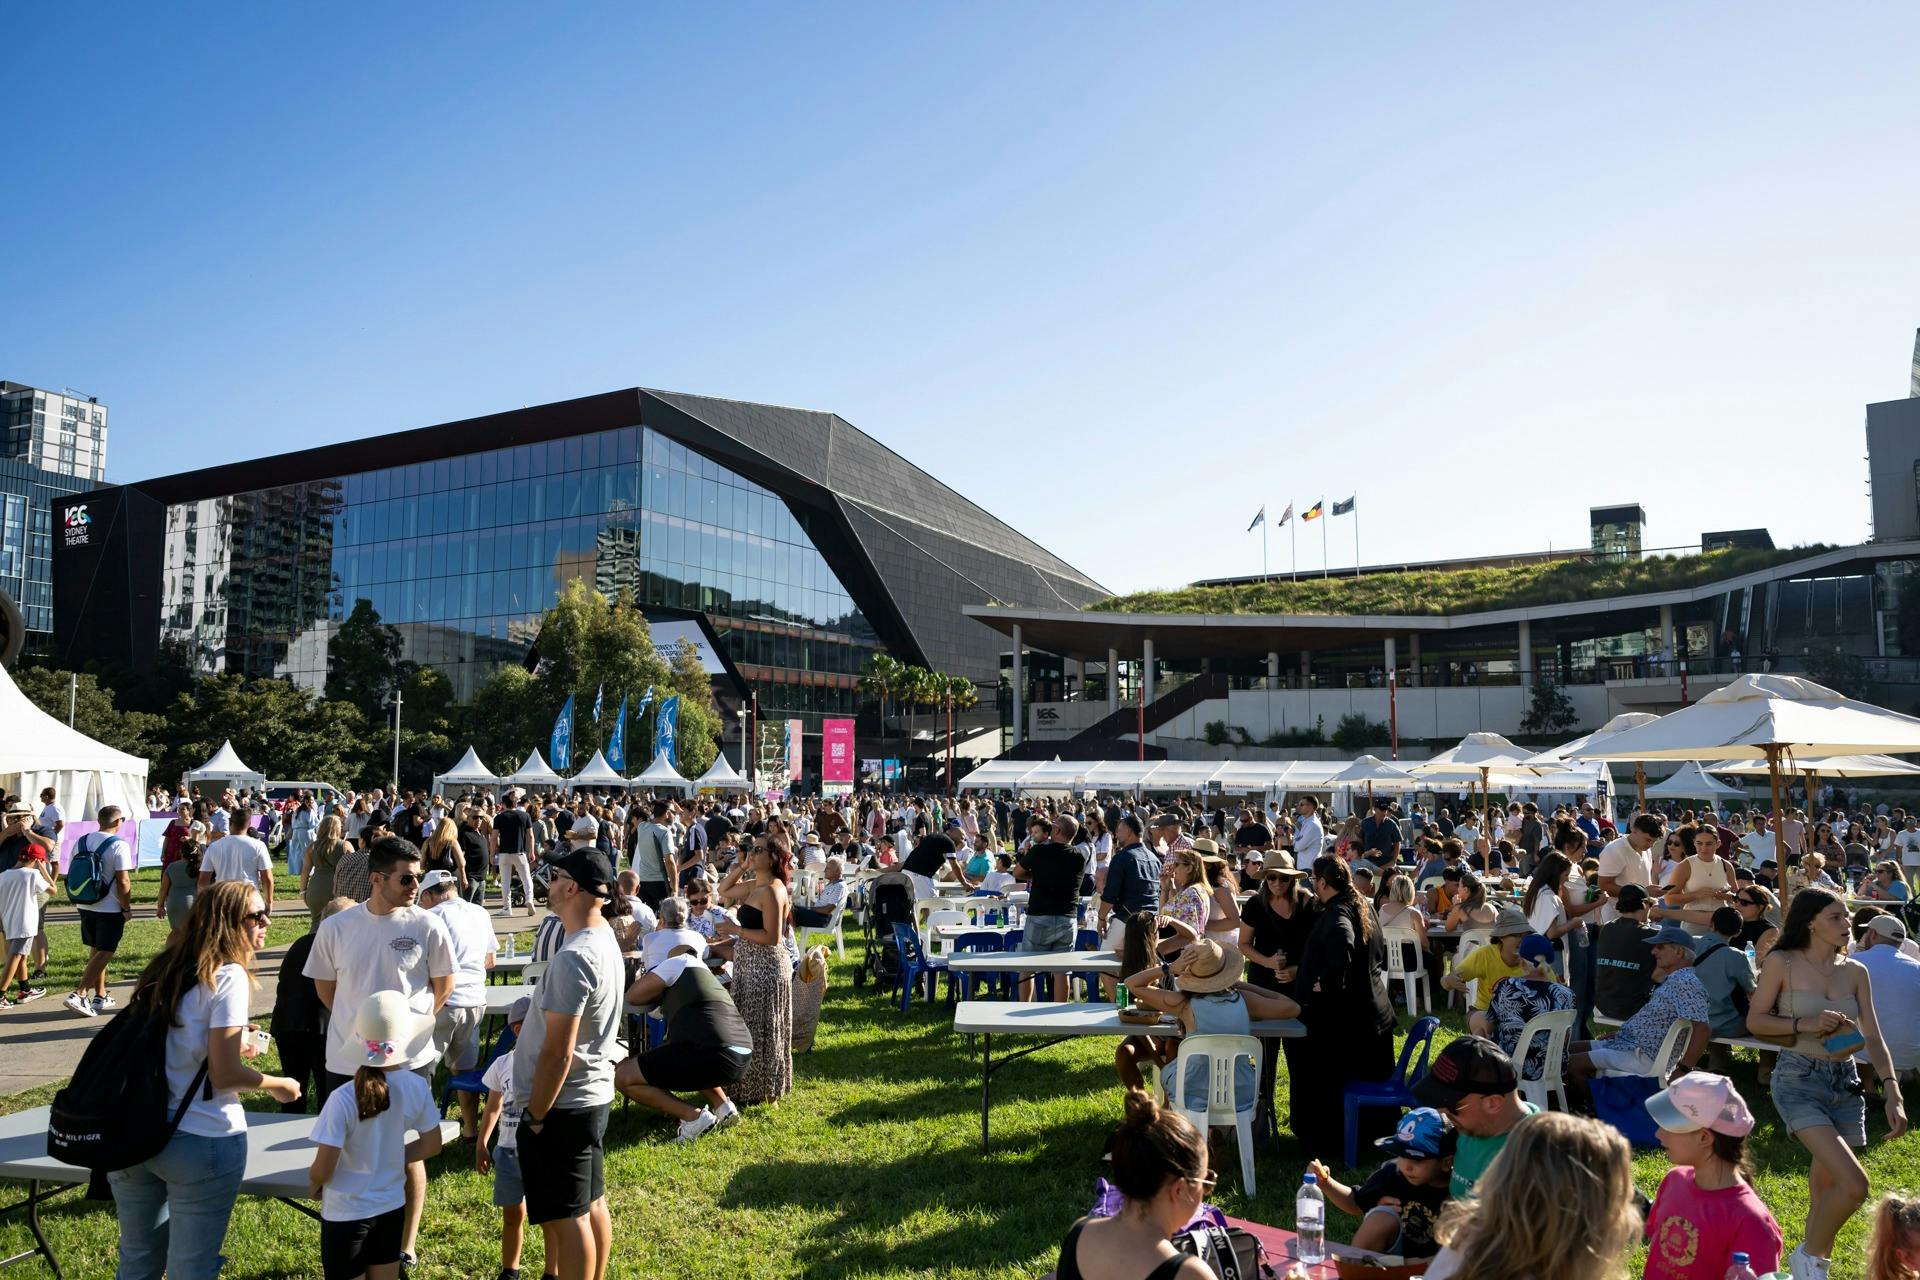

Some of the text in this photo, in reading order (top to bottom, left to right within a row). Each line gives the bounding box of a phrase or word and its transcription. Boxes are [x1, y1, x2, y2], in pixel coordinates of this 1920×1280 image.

[65, 505, 88, 526] ICC
[65, 526, 88, 537] SYDNEY
[65, 535, 89, 546] THEATRE
